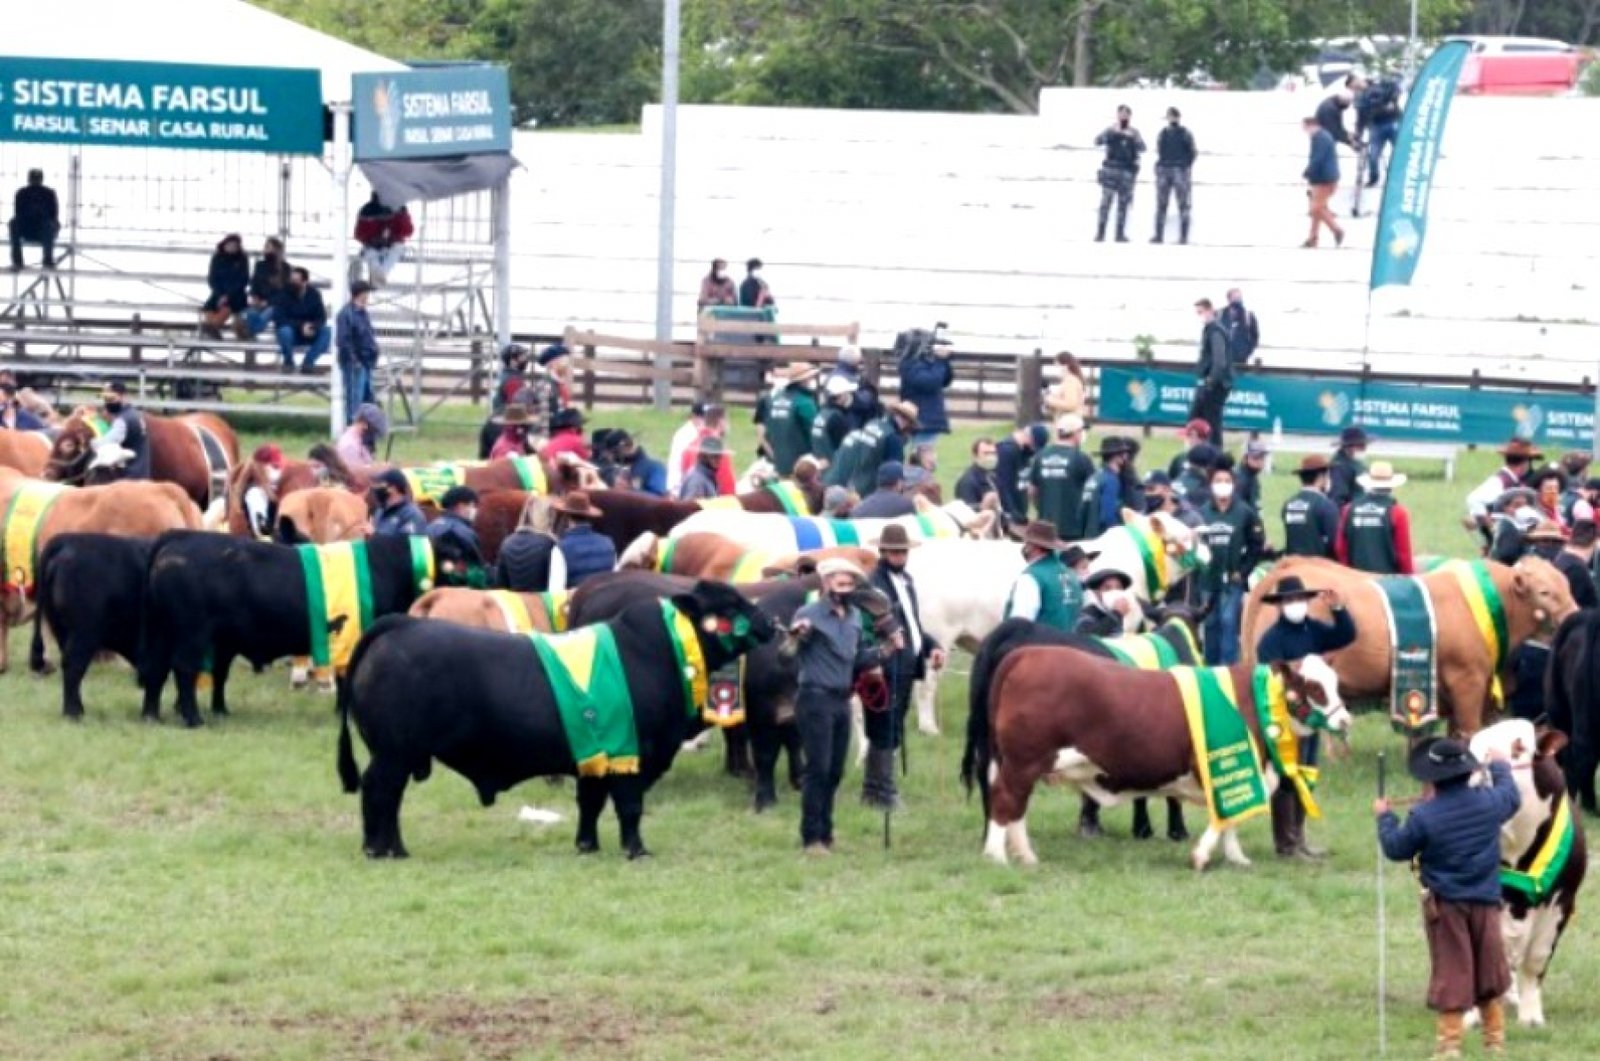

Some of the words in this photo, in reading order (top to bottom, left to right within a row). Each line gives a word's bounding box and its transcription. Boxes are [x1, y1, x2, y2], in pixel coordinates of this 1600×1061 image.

[14, 79, 144, 109] SISTEMA
[152, 84, 268, 115] FARSUL
[403, 93, 450, 118] SISTEMA
[451, 90, 493, 115] FARSUL
[14, 114, 80, 133] FARSUL
[89, 117, 149, 136] SENAR
[159, 121, 206, 138] CASA
[209, 122, 269, 140] RURAL
[1161, 386, 1196, 401] SISTE
[1225, 390, 1268, 406] ARSUL
[1353, 399, 1409, 414] SISTEMA
[1411, 402, 1460, 420] FARSUL
[1547, 411, 1594, 427] SISTEM
